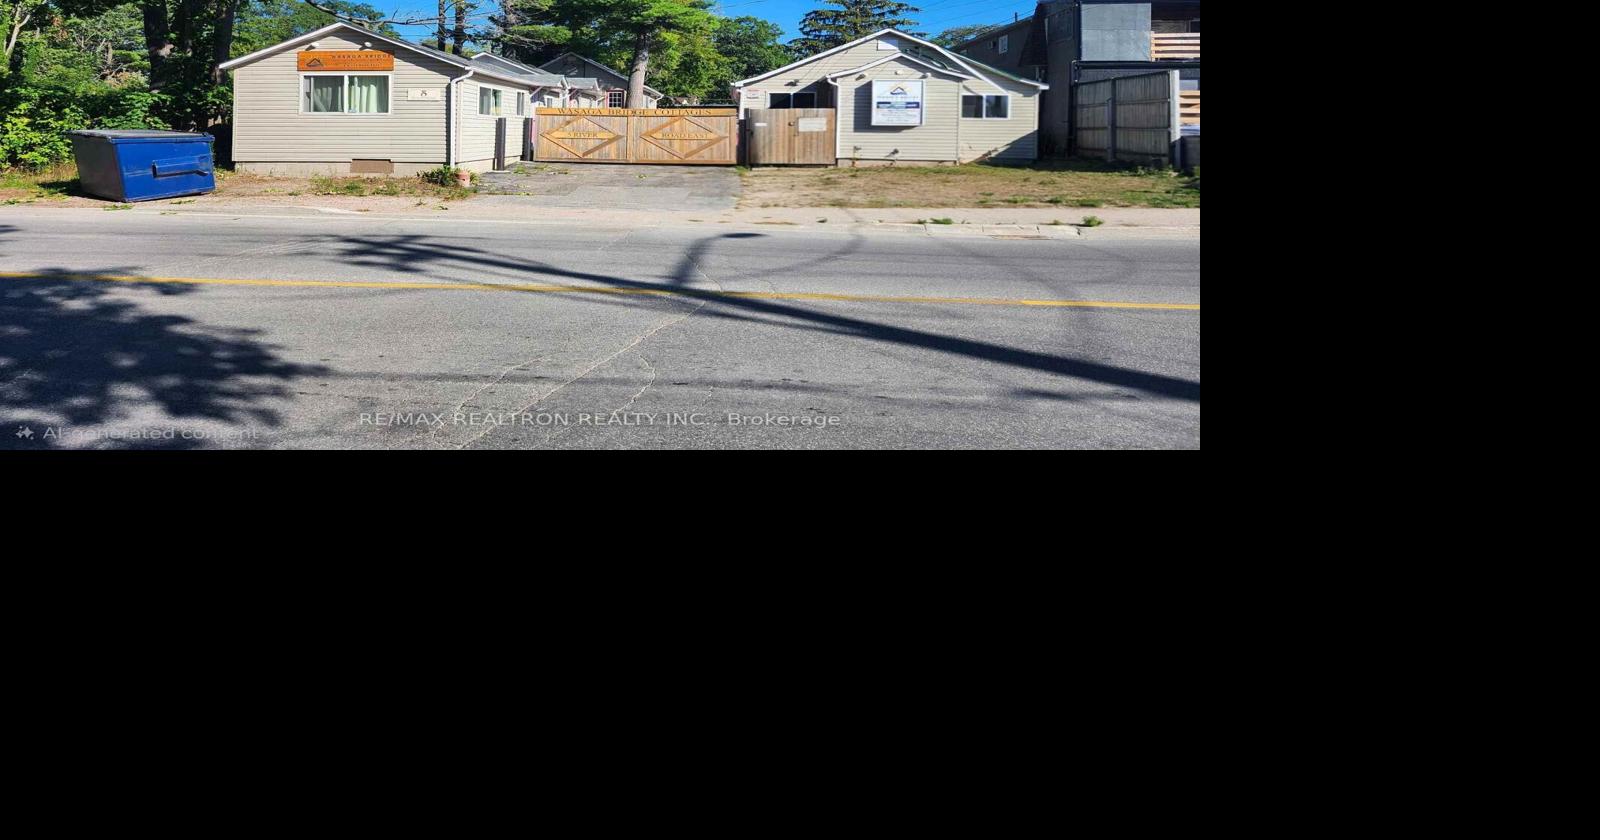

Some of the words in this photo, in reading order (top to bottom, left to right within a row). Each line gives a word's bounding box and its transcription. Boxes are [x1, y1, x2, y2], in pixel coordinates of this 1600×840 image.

[557, 107, 602, 115] WASAGA
[608, 108, 648, 116] BRIDGE
[654, 108, 712, 116] COTTAGES
